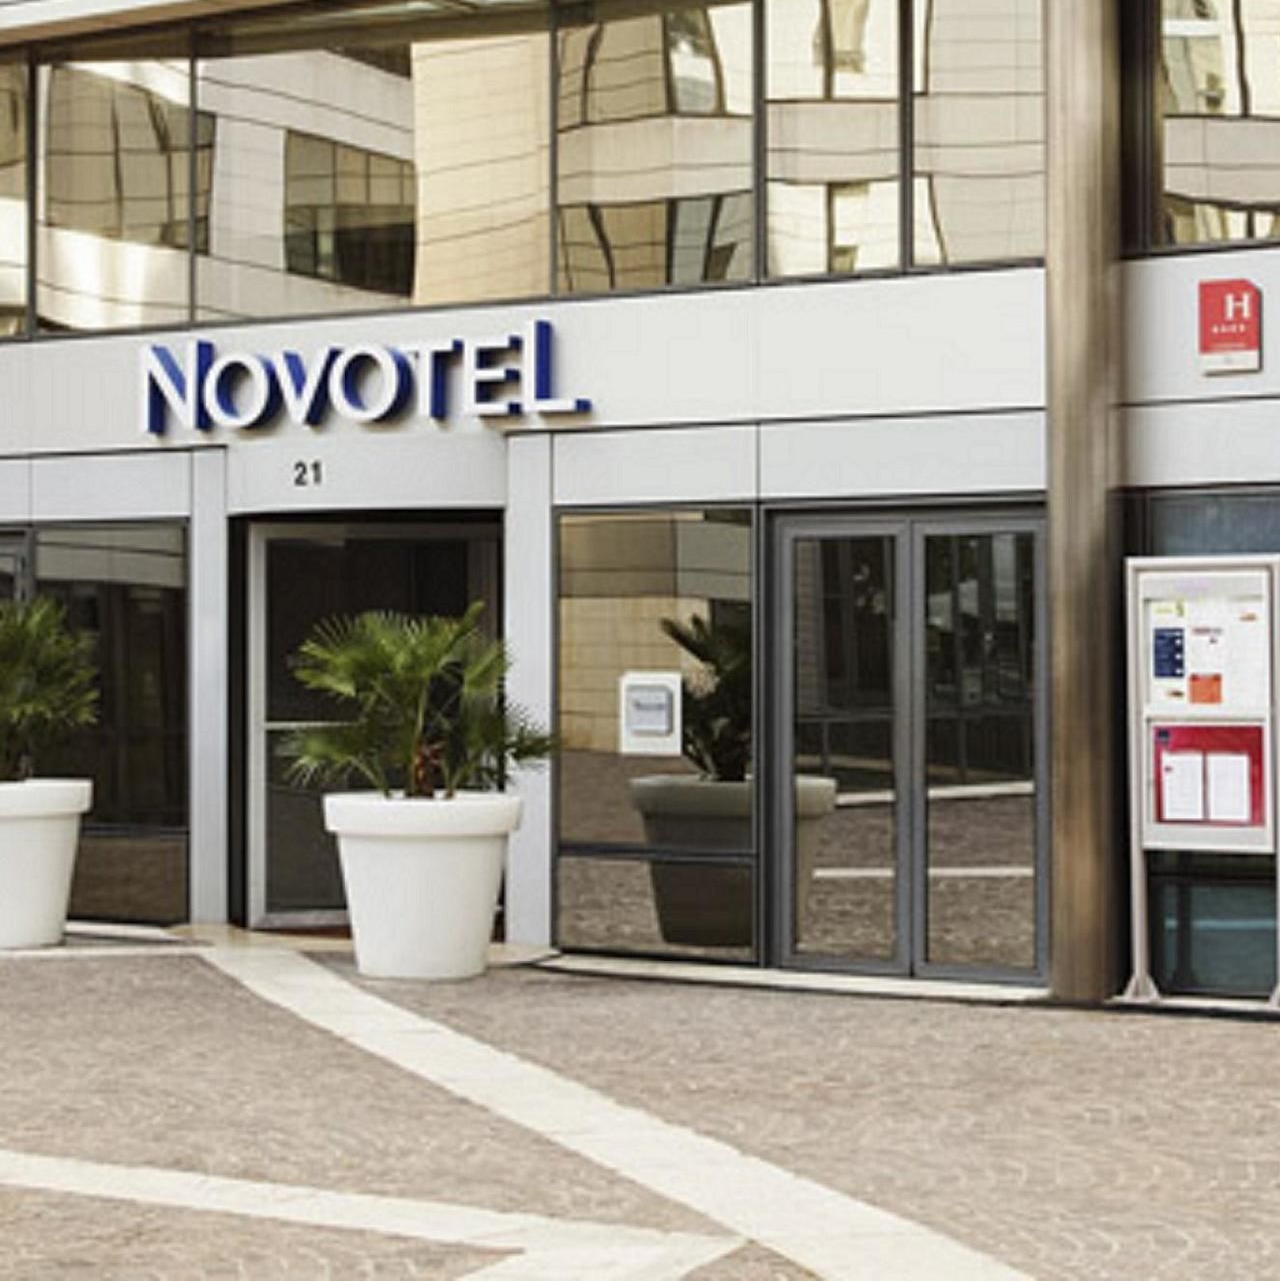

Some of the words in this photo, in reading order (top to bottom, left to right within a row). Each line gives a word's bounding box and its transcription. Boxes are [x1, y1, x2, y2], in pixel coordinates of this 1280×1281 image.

[1224, 291, 1251, 321] H
[143, 319, 592, 436] NOVOTEL
[293, 461, 322, 486] 21
